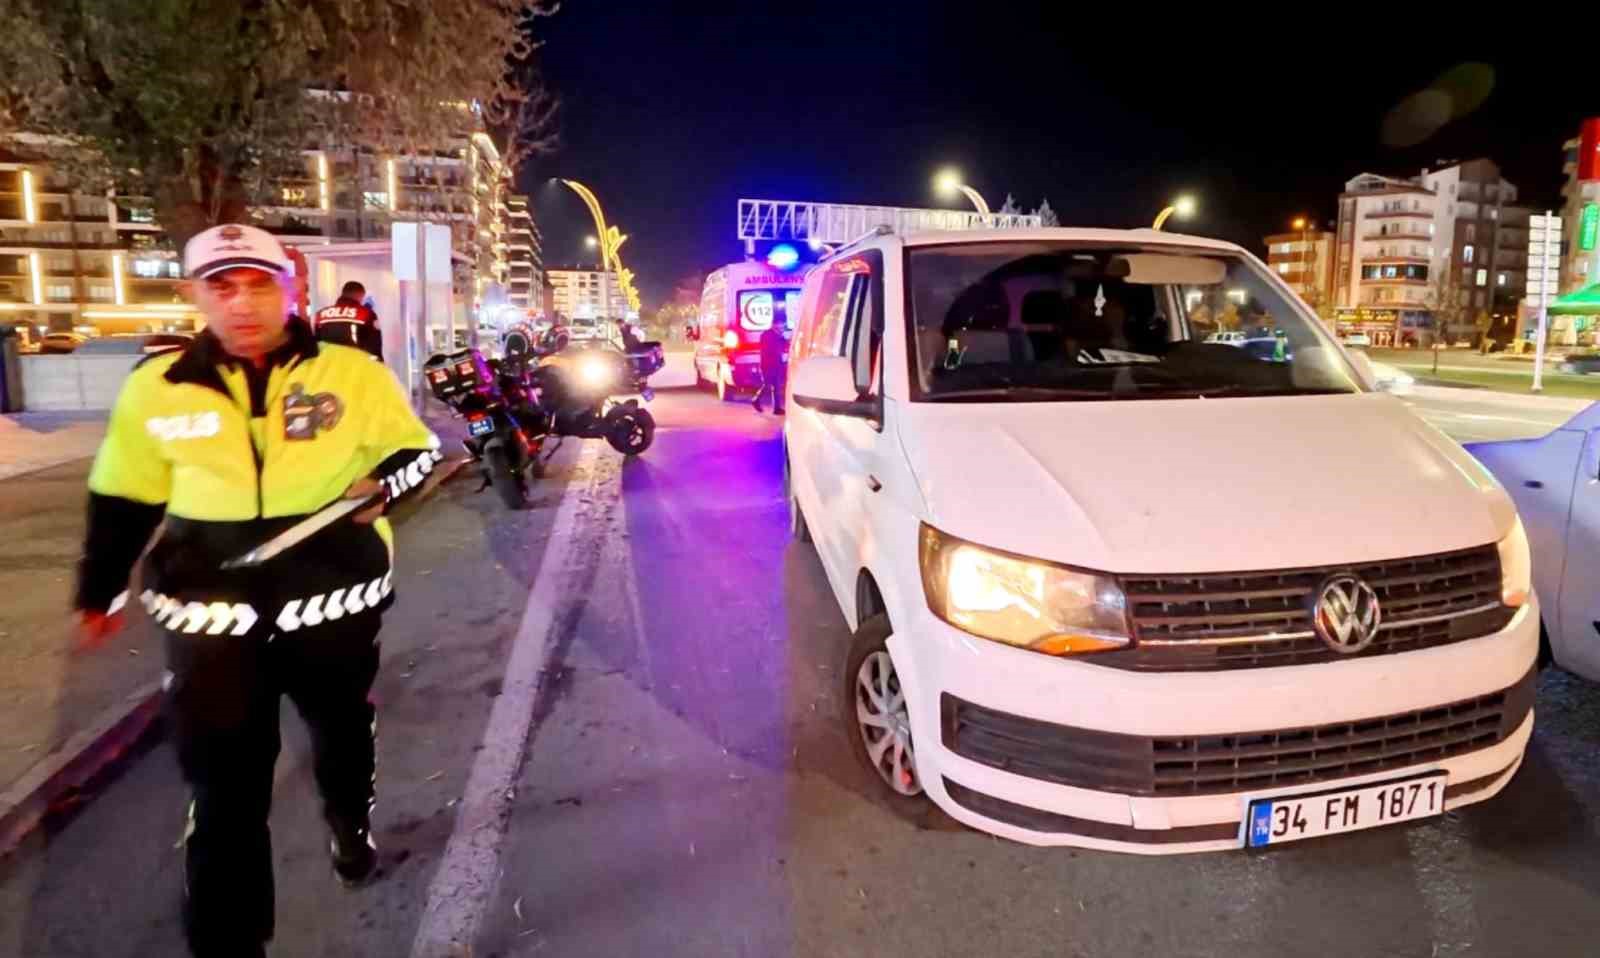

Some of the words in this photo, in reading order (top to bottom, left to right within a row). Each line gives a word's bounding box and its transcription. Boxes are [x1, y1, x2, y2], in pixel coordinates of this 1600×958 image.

[752, 306, 771, 316] 112
[1272, 804, 1308, 837] 34
[1324, 795, 1360, 829] FM
[1376, 782, 1438, 820] 1871
